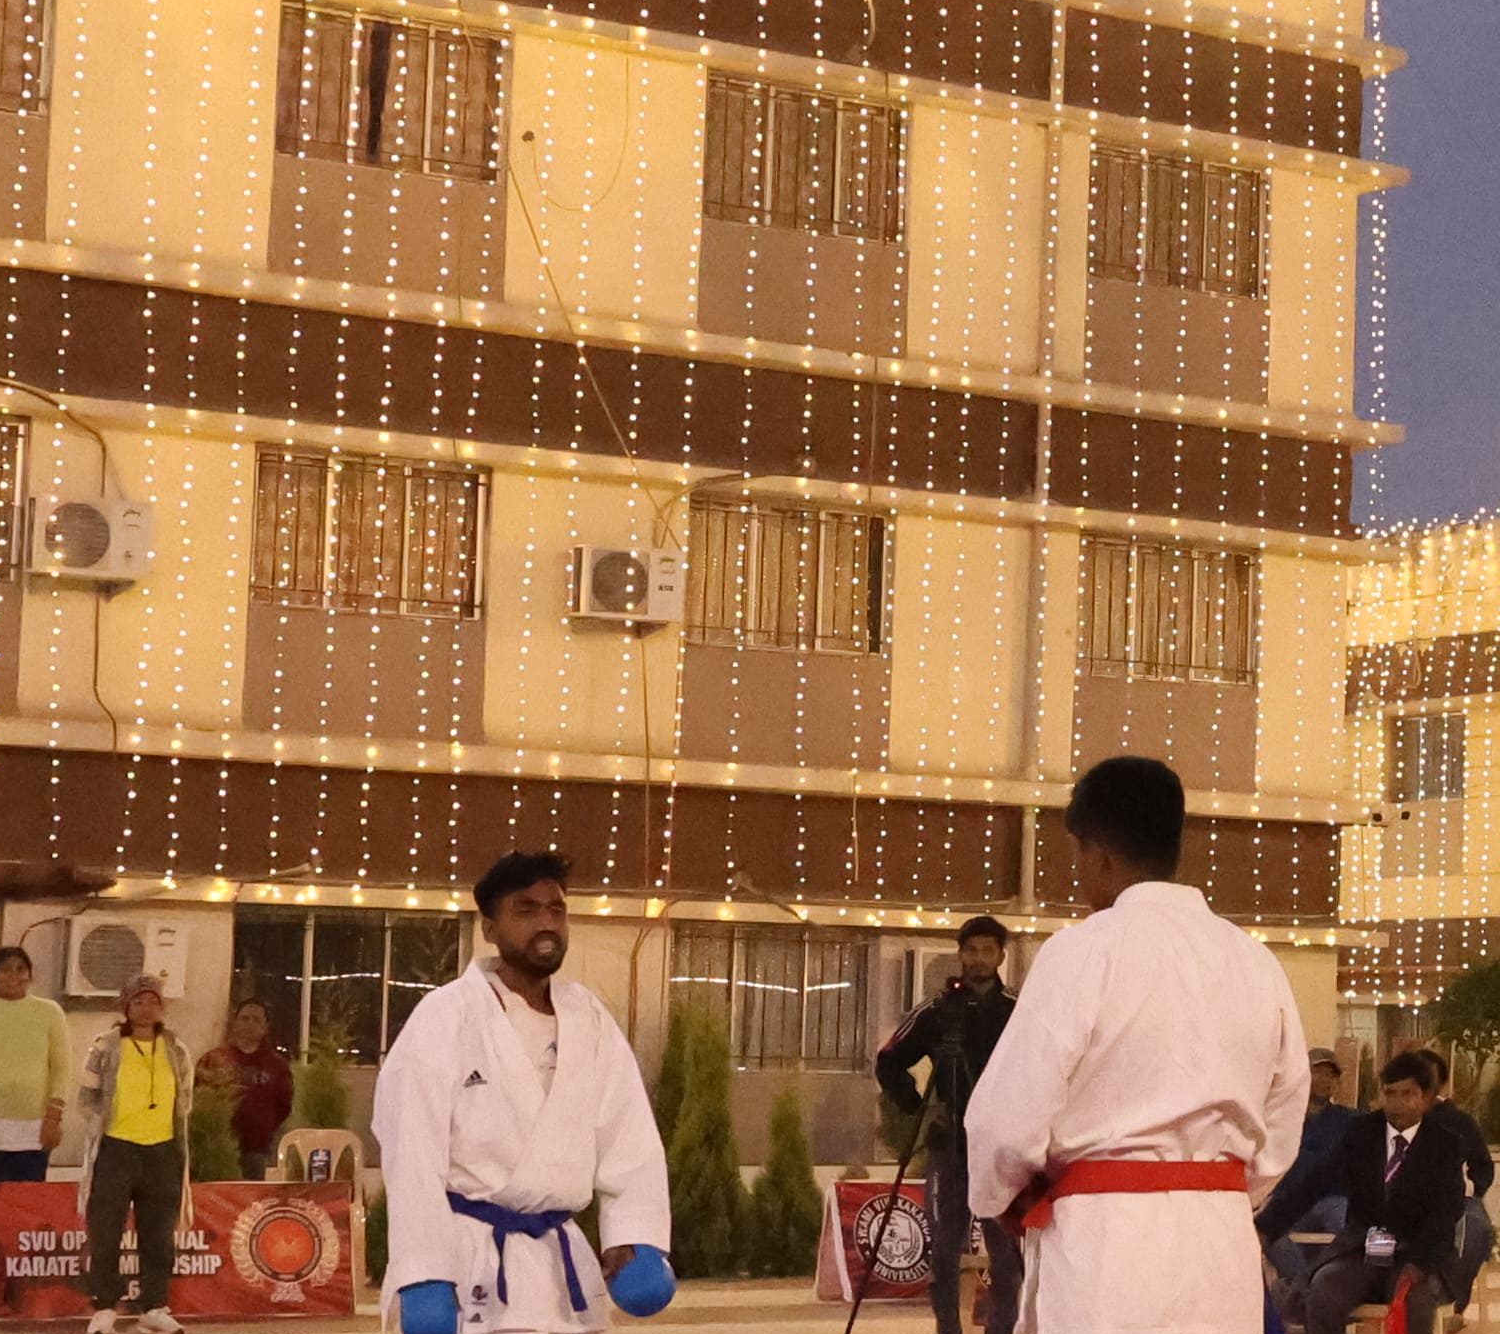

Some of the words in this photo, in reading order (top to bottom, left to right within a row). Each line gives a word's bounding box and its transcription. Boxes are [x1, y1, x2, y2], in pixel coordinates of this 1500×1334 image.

[18, 1230, 56, 1251] SVU
[5, 1255, 81, 1277] KARATE
[873, 1258, 930, 1282] UNIVERSITY
